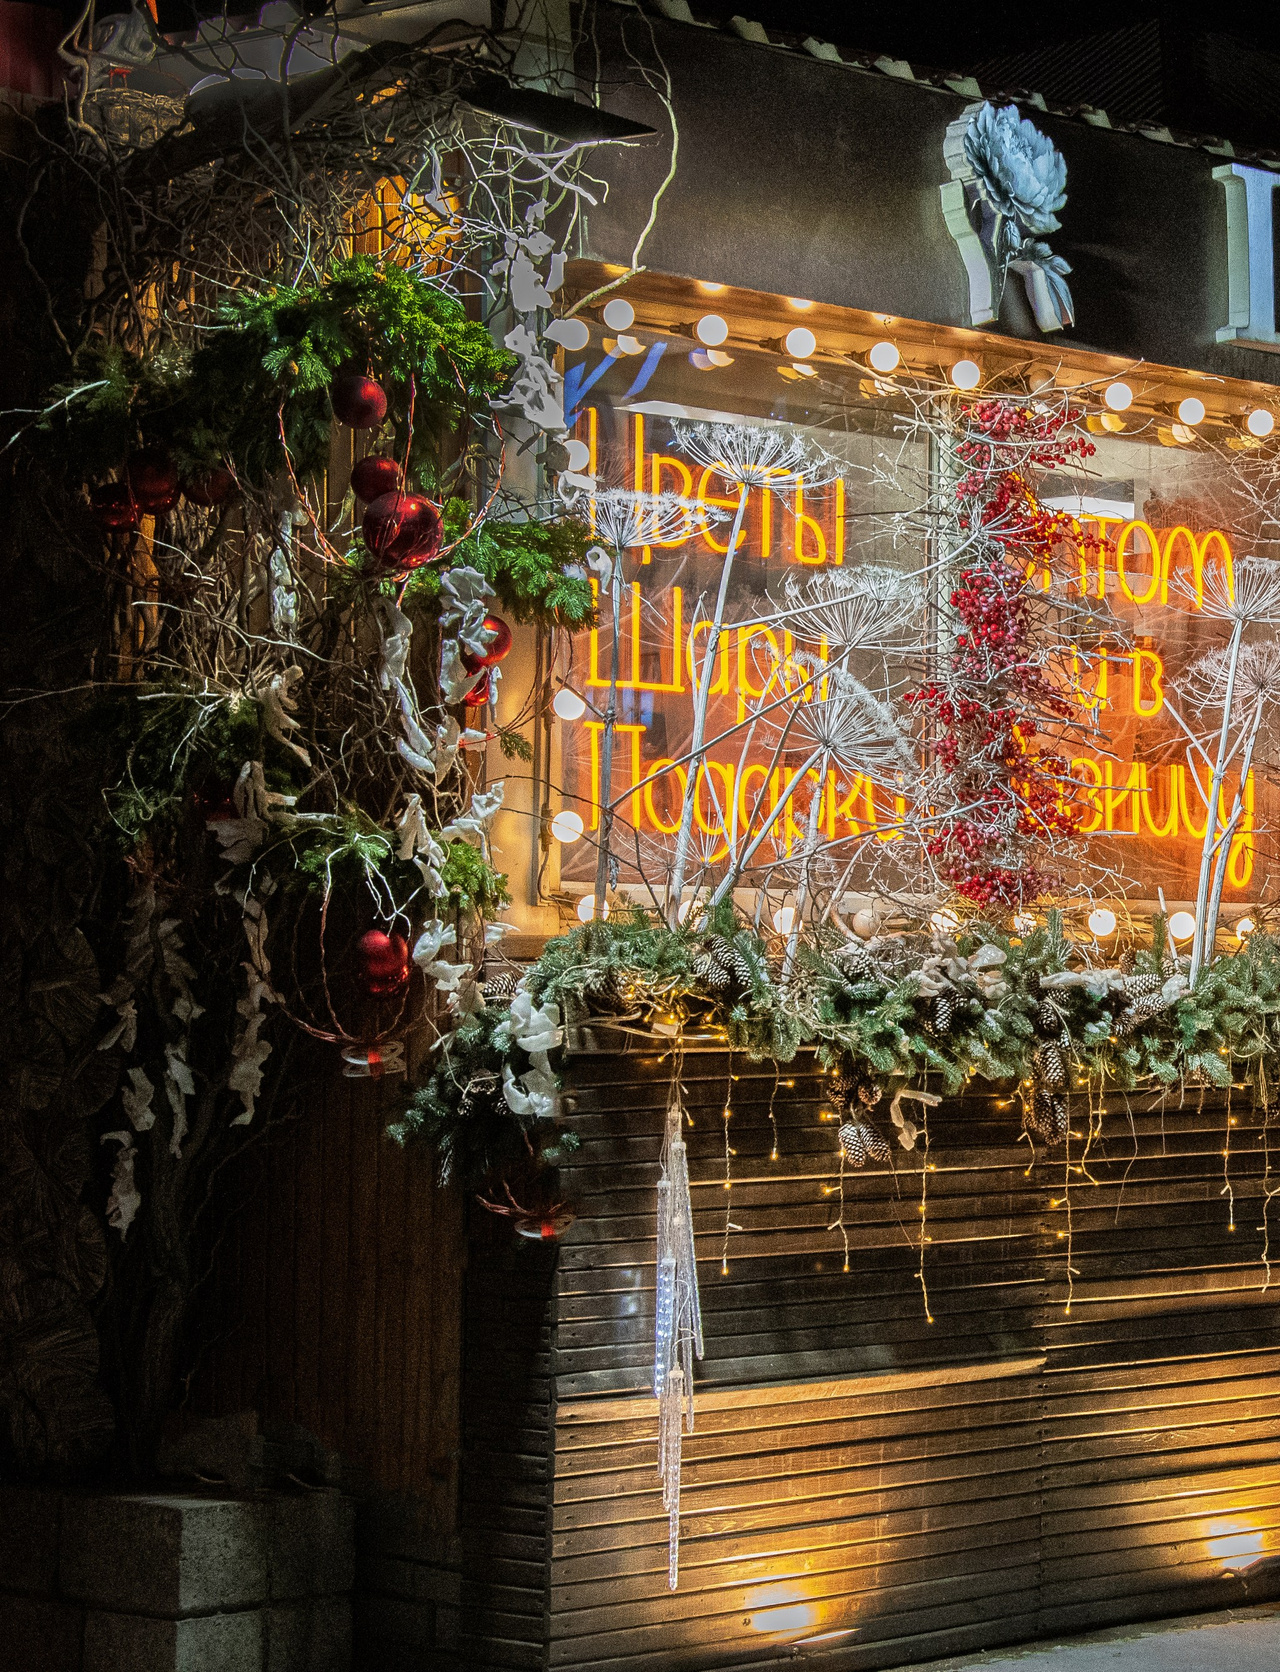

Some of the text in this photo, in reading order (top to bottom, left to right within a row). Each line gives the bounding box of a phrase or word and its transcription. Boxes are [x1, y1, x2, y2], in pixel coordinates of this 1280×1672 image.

[584, 406, 845, 566] Цветы
[585, 577, 828, 725] Шары
[583, 721, 904, 864] Подарки
